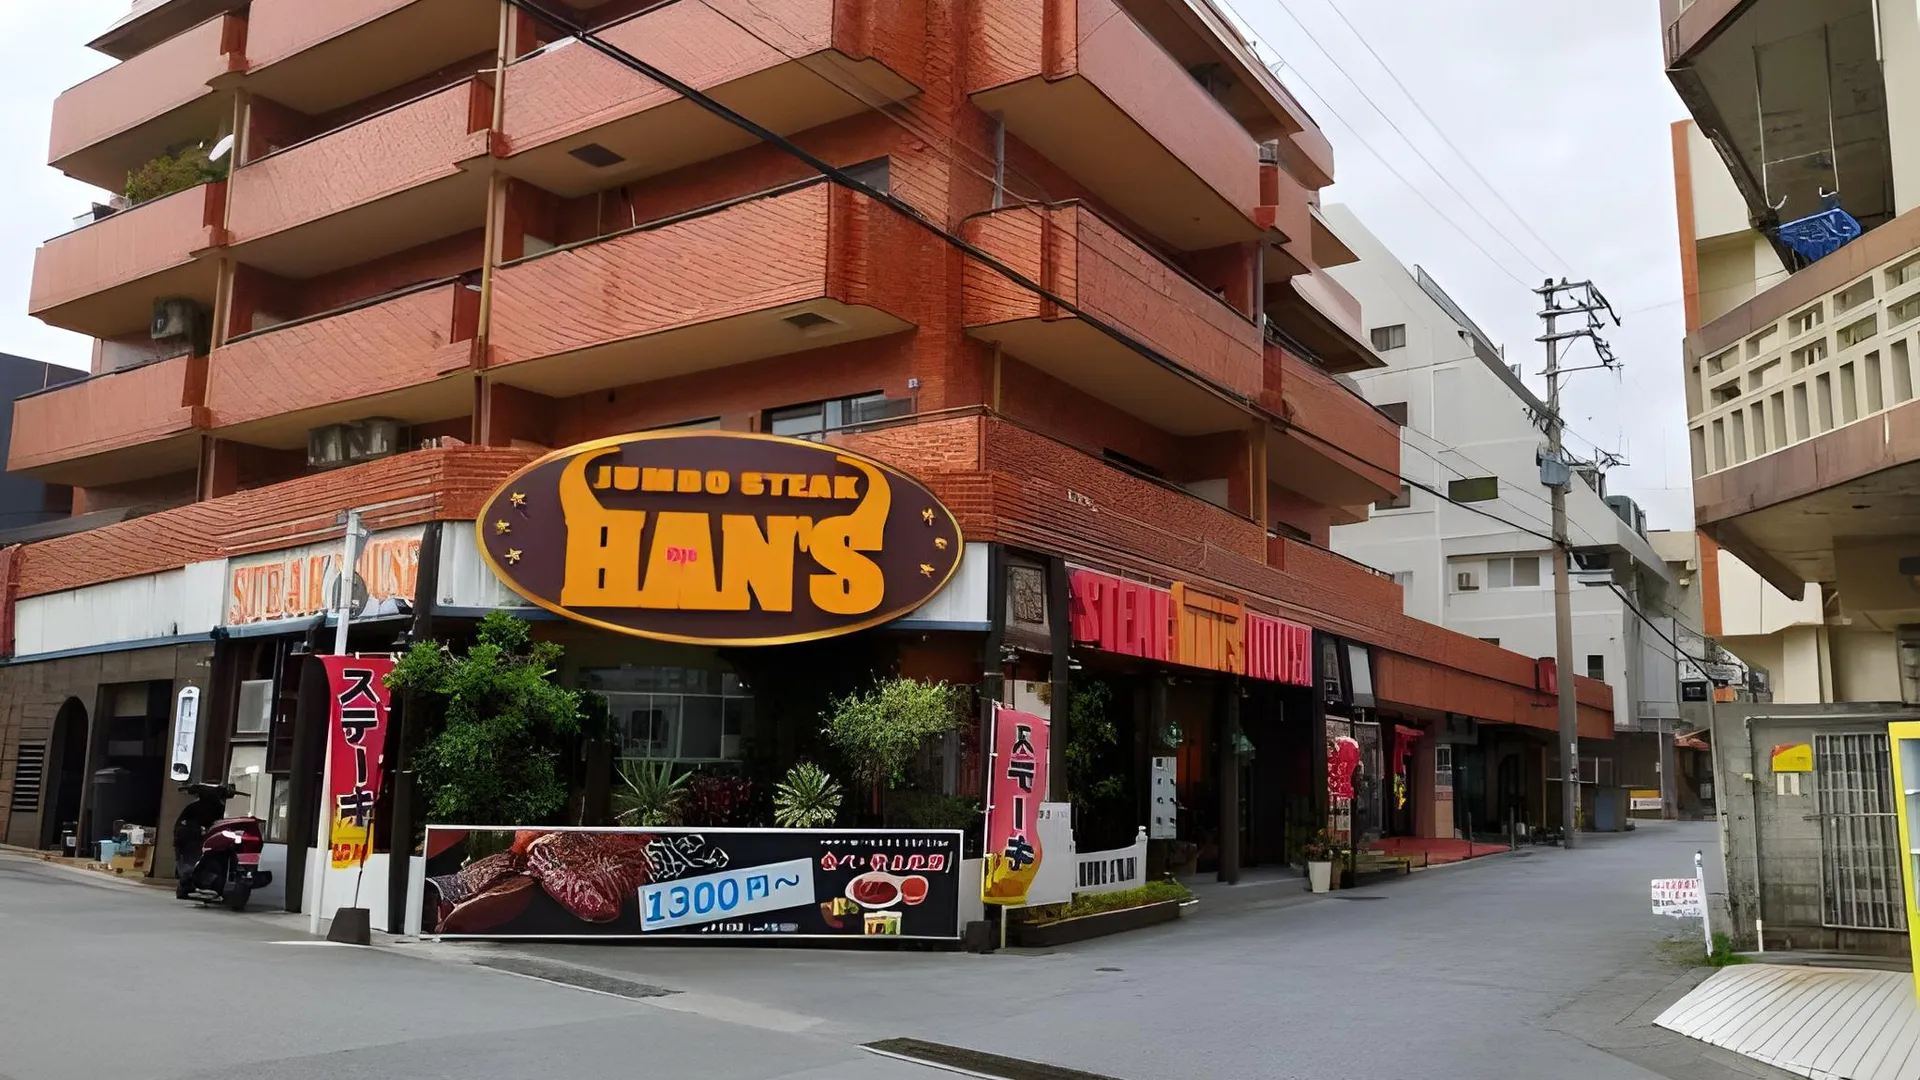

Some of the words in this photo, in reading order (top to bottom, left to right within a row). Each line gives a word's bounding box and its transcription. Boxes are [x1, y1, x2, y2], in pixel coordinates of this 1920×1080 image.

[740, 472, 859, 499] STEAK
[337, 668, 381, 828] ステーキ
